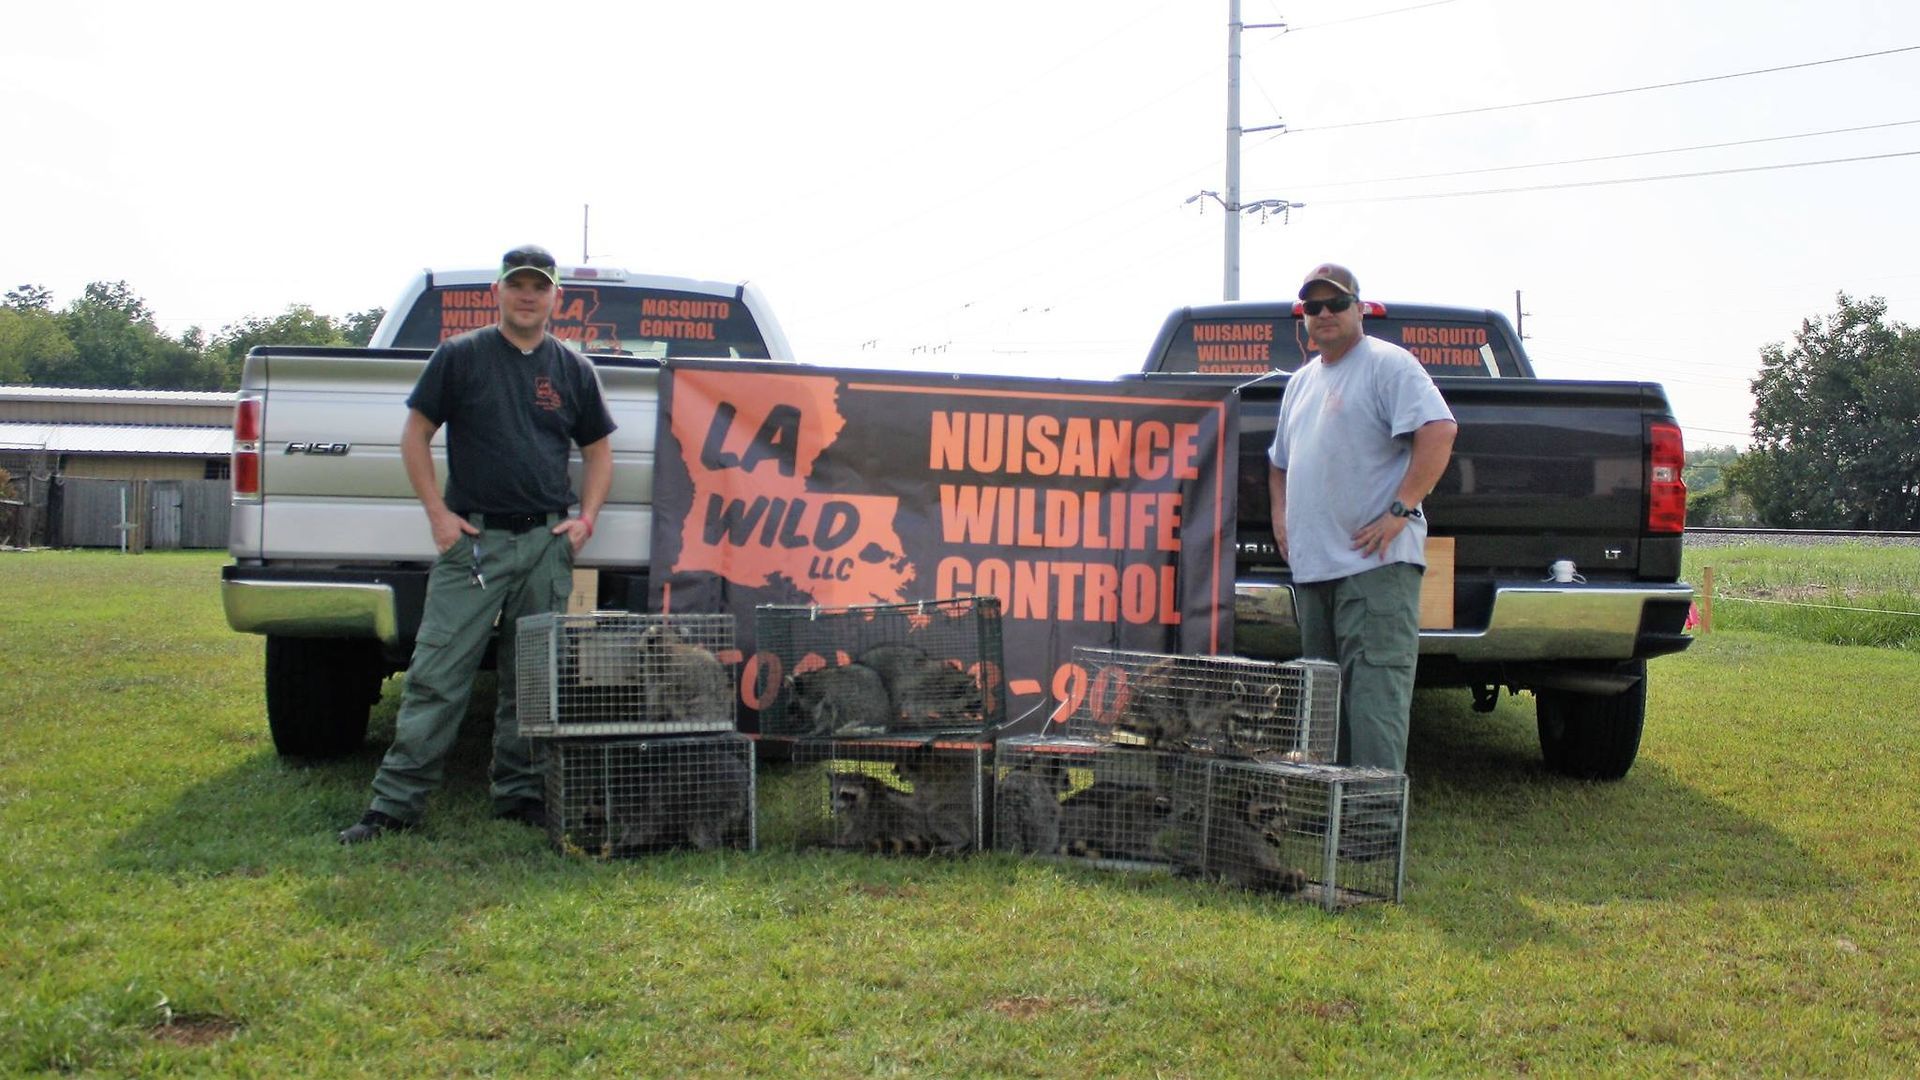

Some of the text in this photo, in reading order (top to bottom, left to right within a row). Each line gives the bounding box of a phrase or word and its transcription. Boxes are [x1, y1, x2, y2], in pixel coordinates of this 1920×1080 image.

[552, 297, 585, 321] LA
[641, 298, 729, 320] MOSQUITO
[640, 319, 716, 340] CONTROL
[1193, 323, 1273, 342] NUISANCE
[1402, 326, 1487, 346] MOSQUITO
[1196, 343, 1270, 362] WILDLIFE
[700, 400, 802, 478] LA
[929, 411, 1199, 480] NUISANCE
[703, 493, 861, 552] WILD
[938, 484, 1182, 552] WILDLIFE
[1604, 549, 1622, 560] LT
[807, 556, 855, 582] LLC
[935, 556, 1181, 625] CONTROL
